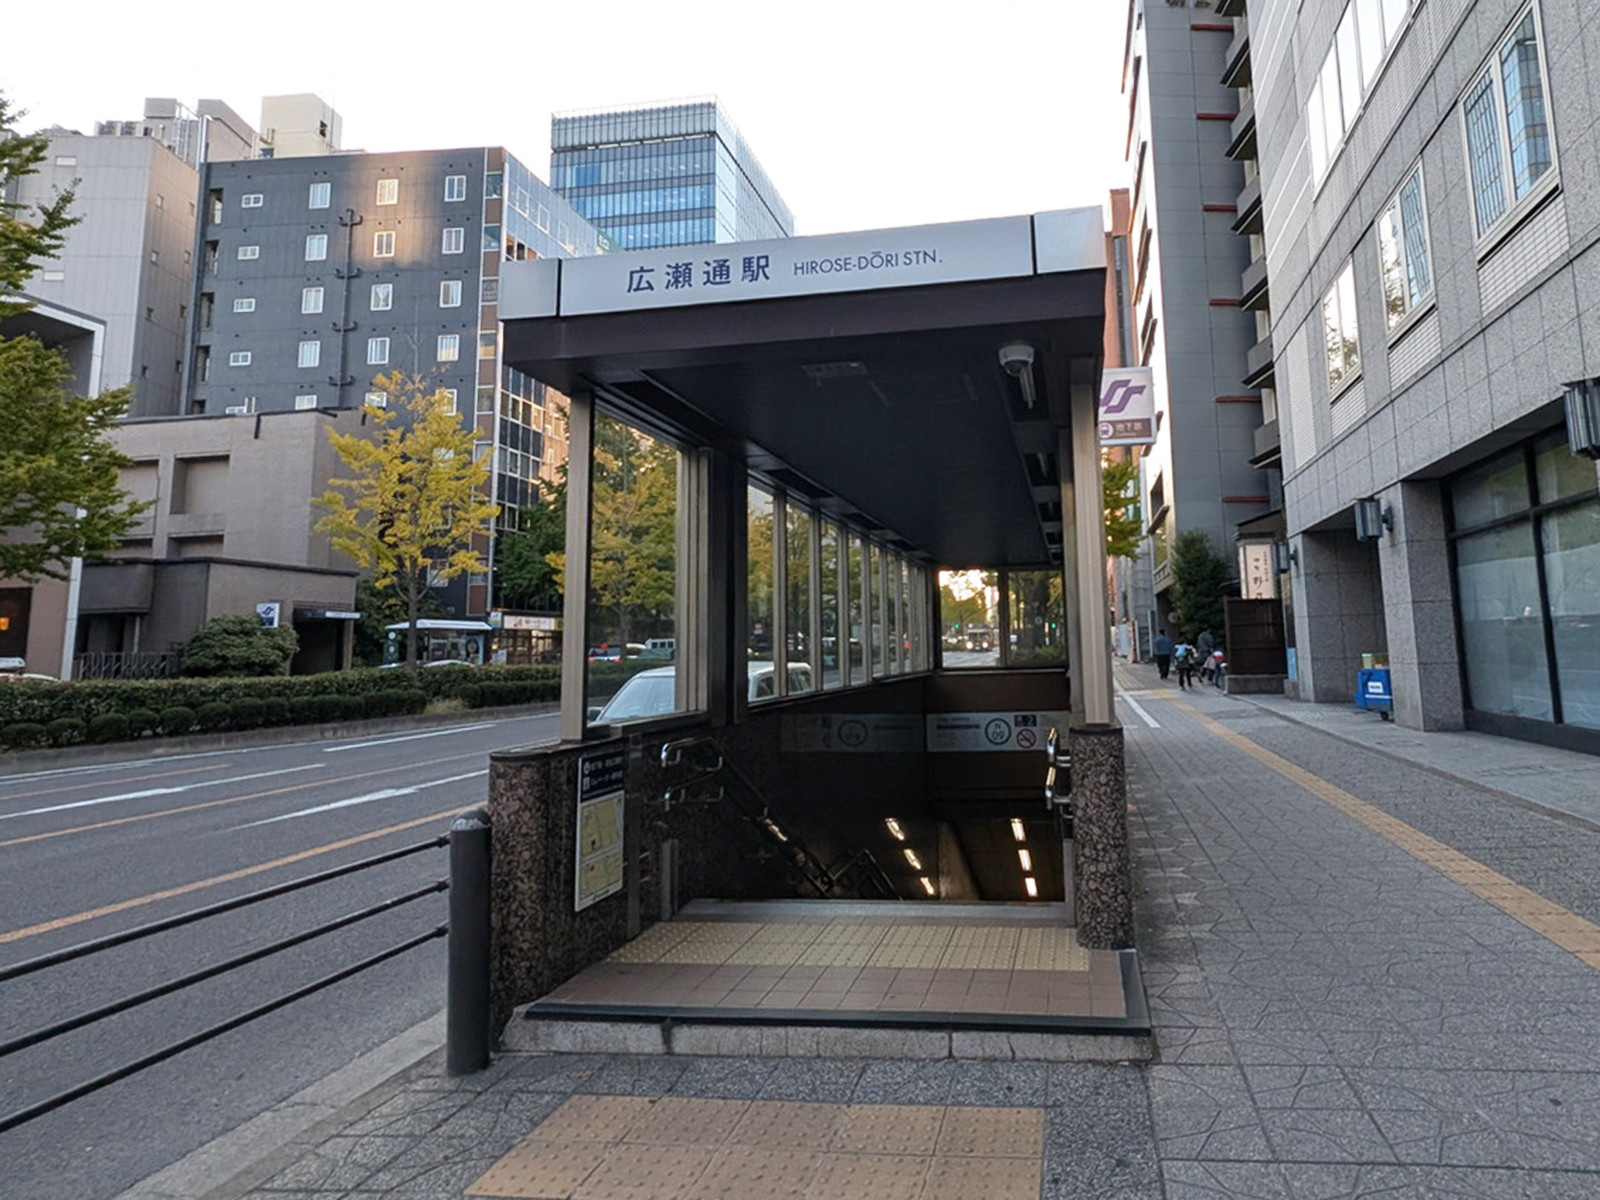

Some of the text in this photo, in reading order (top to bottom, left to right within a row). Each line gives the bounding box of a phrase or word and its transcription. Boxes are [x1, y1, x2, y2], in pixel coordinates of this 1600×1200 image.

[626, 255, 770, 293] 広瀬通駅
[794, 249, 943, 276] HIROSE-DŌRI STN.
